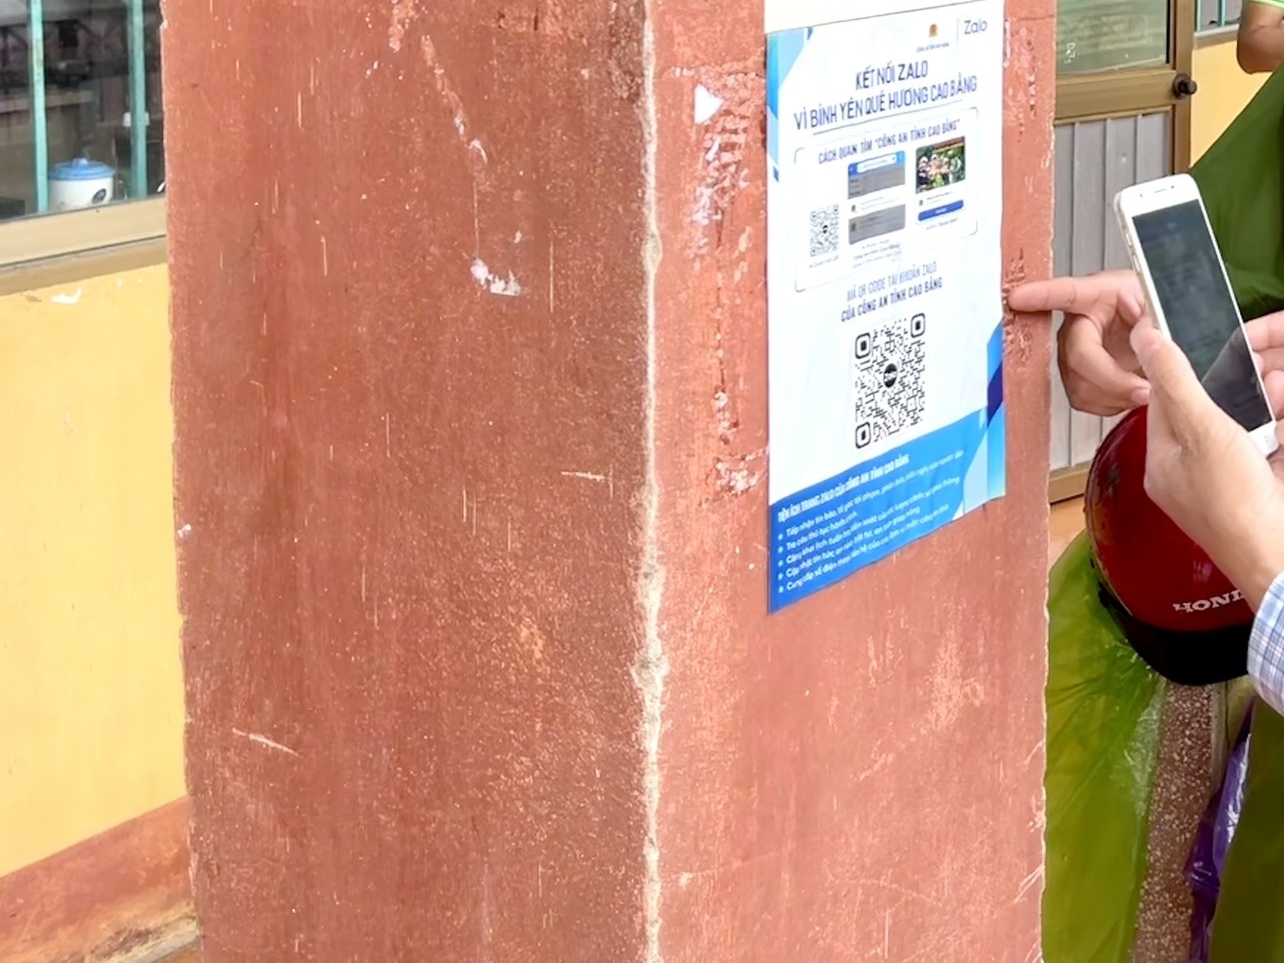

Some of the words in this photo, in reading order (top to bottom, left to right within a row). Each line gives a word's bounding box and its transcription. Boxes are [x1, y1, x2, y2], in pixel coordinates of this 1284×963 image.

[964, 18, 988, 35] Zalo
[855, 64, 875, 90] KẾT
[877, 60, 896, 86] NỐI
[898, 59, 928, 82] ZALO
[793, 106, 808, 131] VÌ
[810, 103, 838, 129] BÌNH
[839, 96, 864, 120] YÊN
[865, 90, 886, 116] QUÊ
[888, 86, 928, 110] HƯƠNG
[930, 82, 949, 102] CAO
[950, 71, 977, 97] BẰNG
